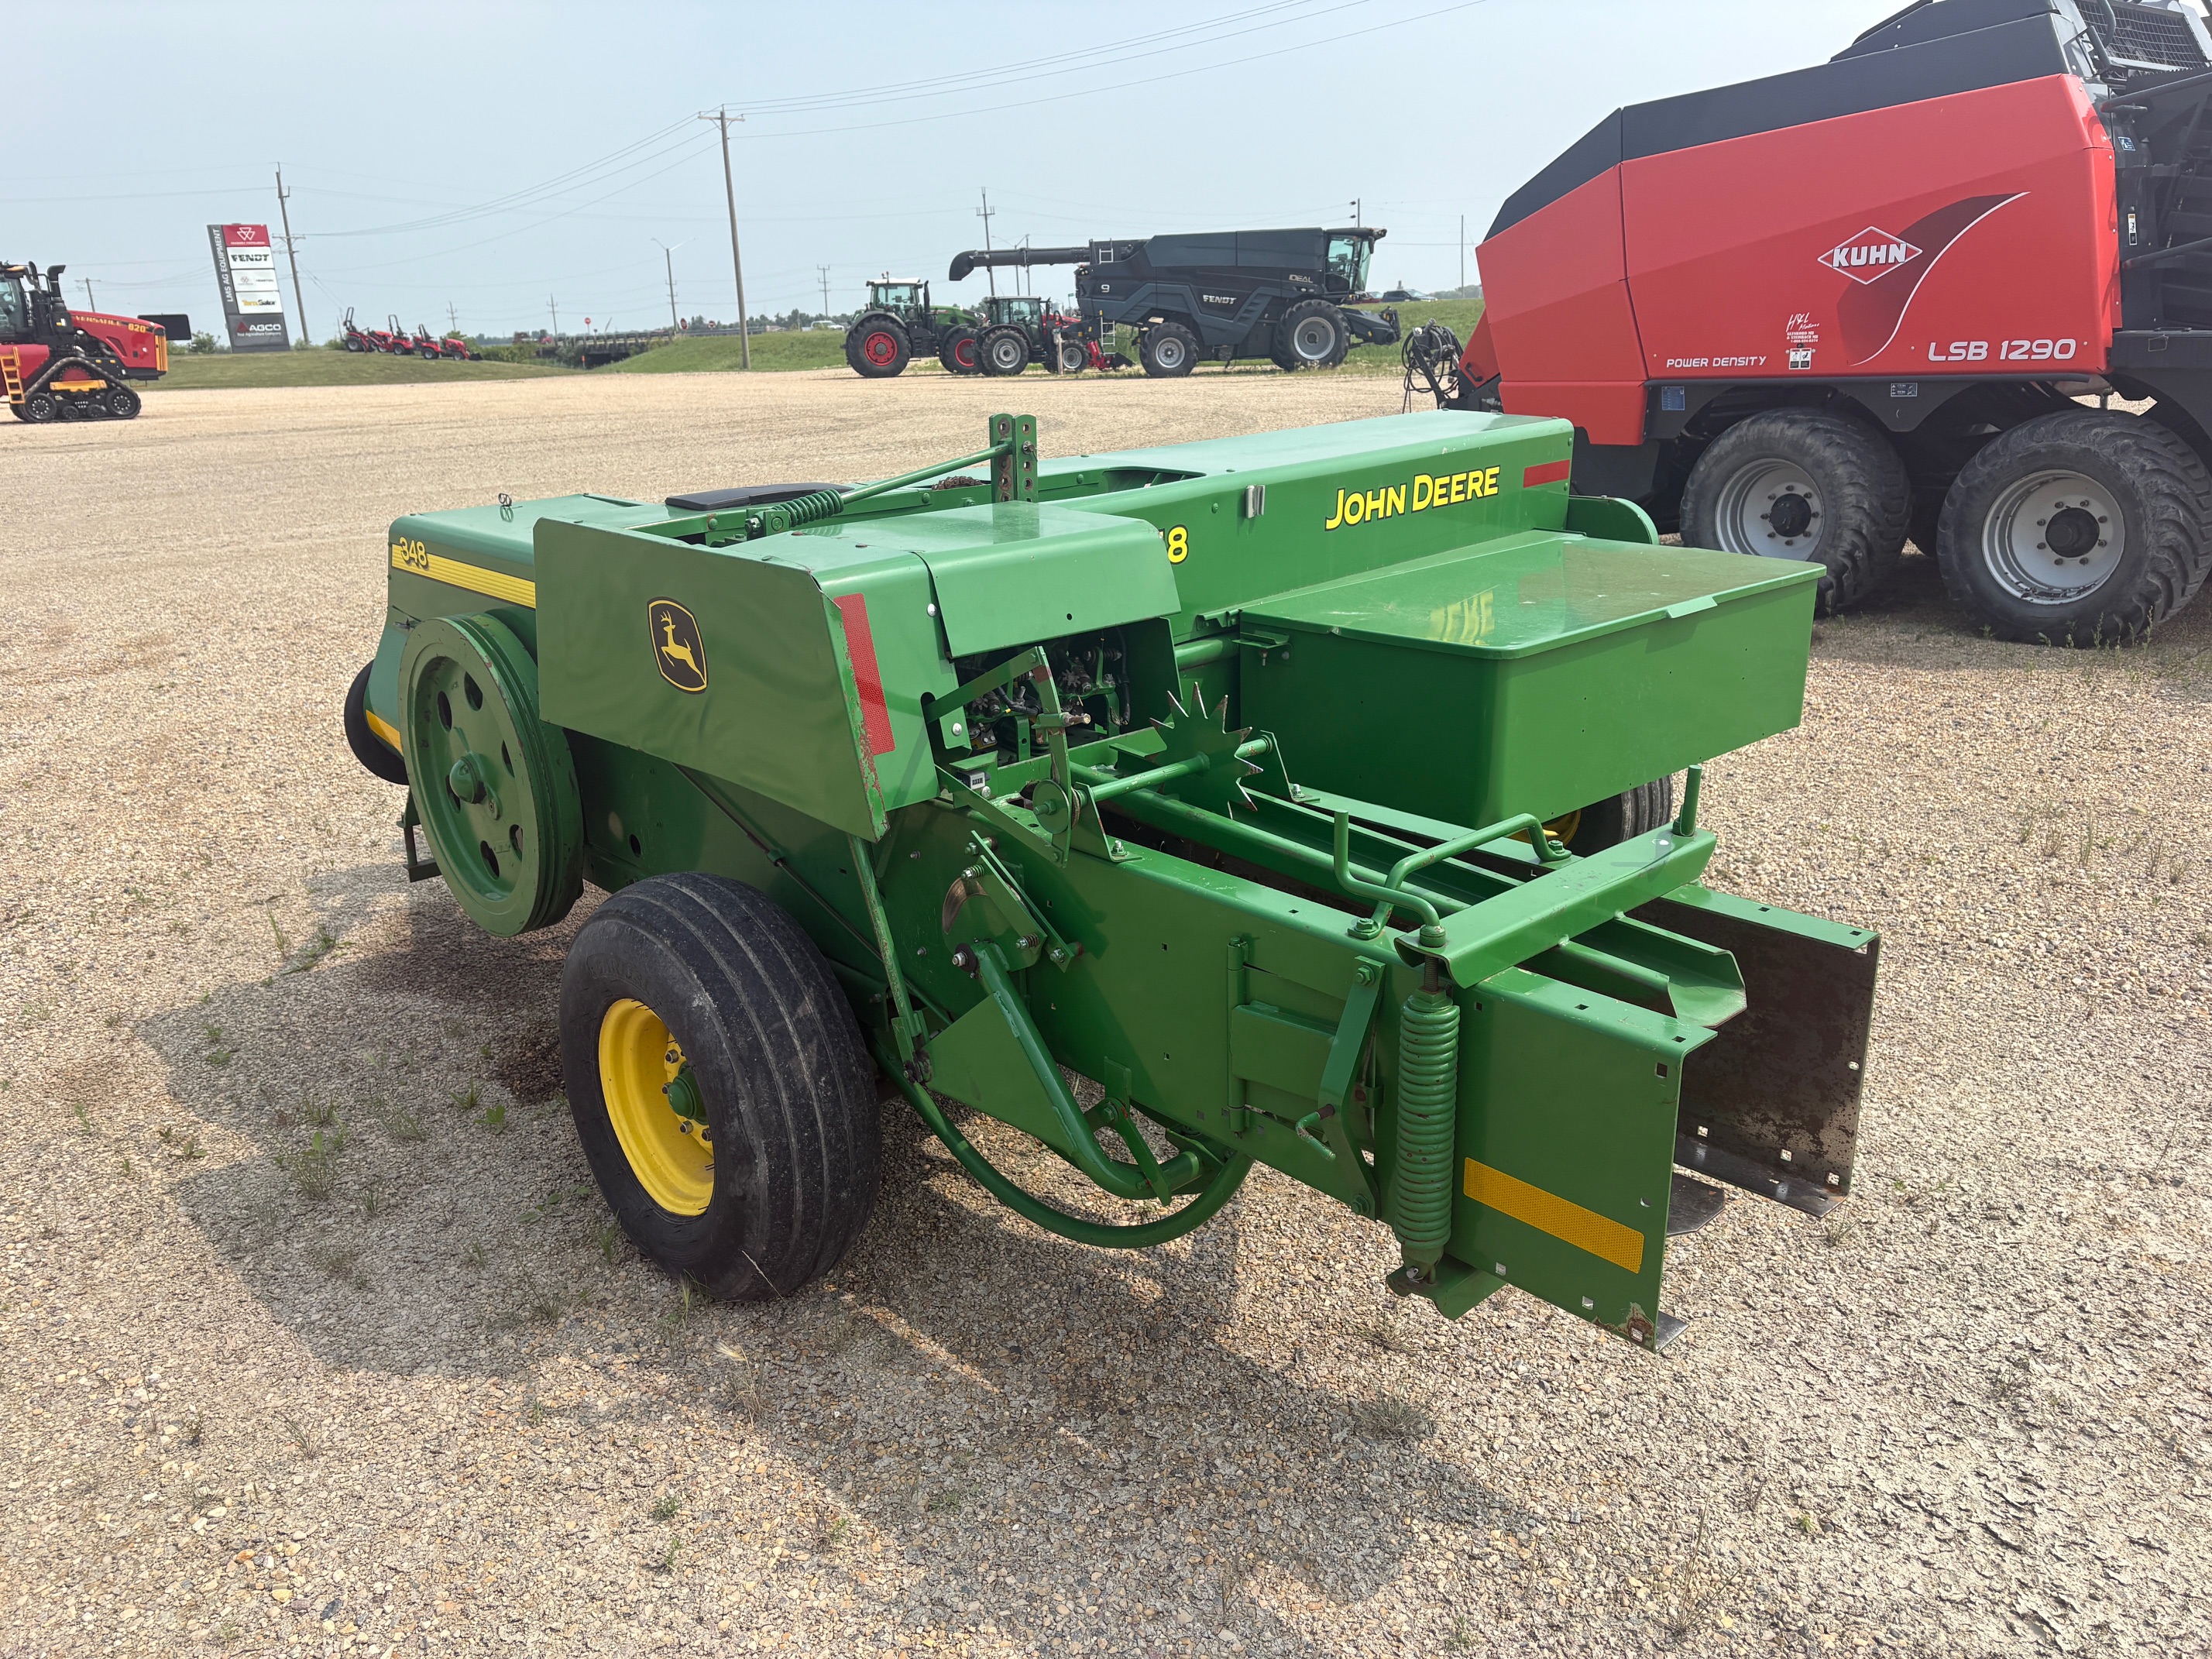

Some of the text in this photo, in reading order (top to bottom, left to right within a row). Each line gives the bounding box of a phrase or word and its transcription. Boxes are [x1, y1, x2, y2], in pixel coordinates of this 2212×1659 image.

[212, 228, 233, 302] LMS AG EQUIPMENT
[1832, 243, 1907, 267] KUHN
[1101, 284, 1110, 293] 9
[1289, 274, 1314, 283] IDEAL
[1203, 294, 1237, 304] FENDT
[75, 315, 122, 325] VERSATILE
[1666, 356, 1767, 368] POWER DENSITY
[1928, 338, 2076, 362] LSB 1290
[1324, 465, 1500, 531] JOHN DEERE
[399, 536, 429, 568] 348
[1159, 524, 1188, 565] 8
